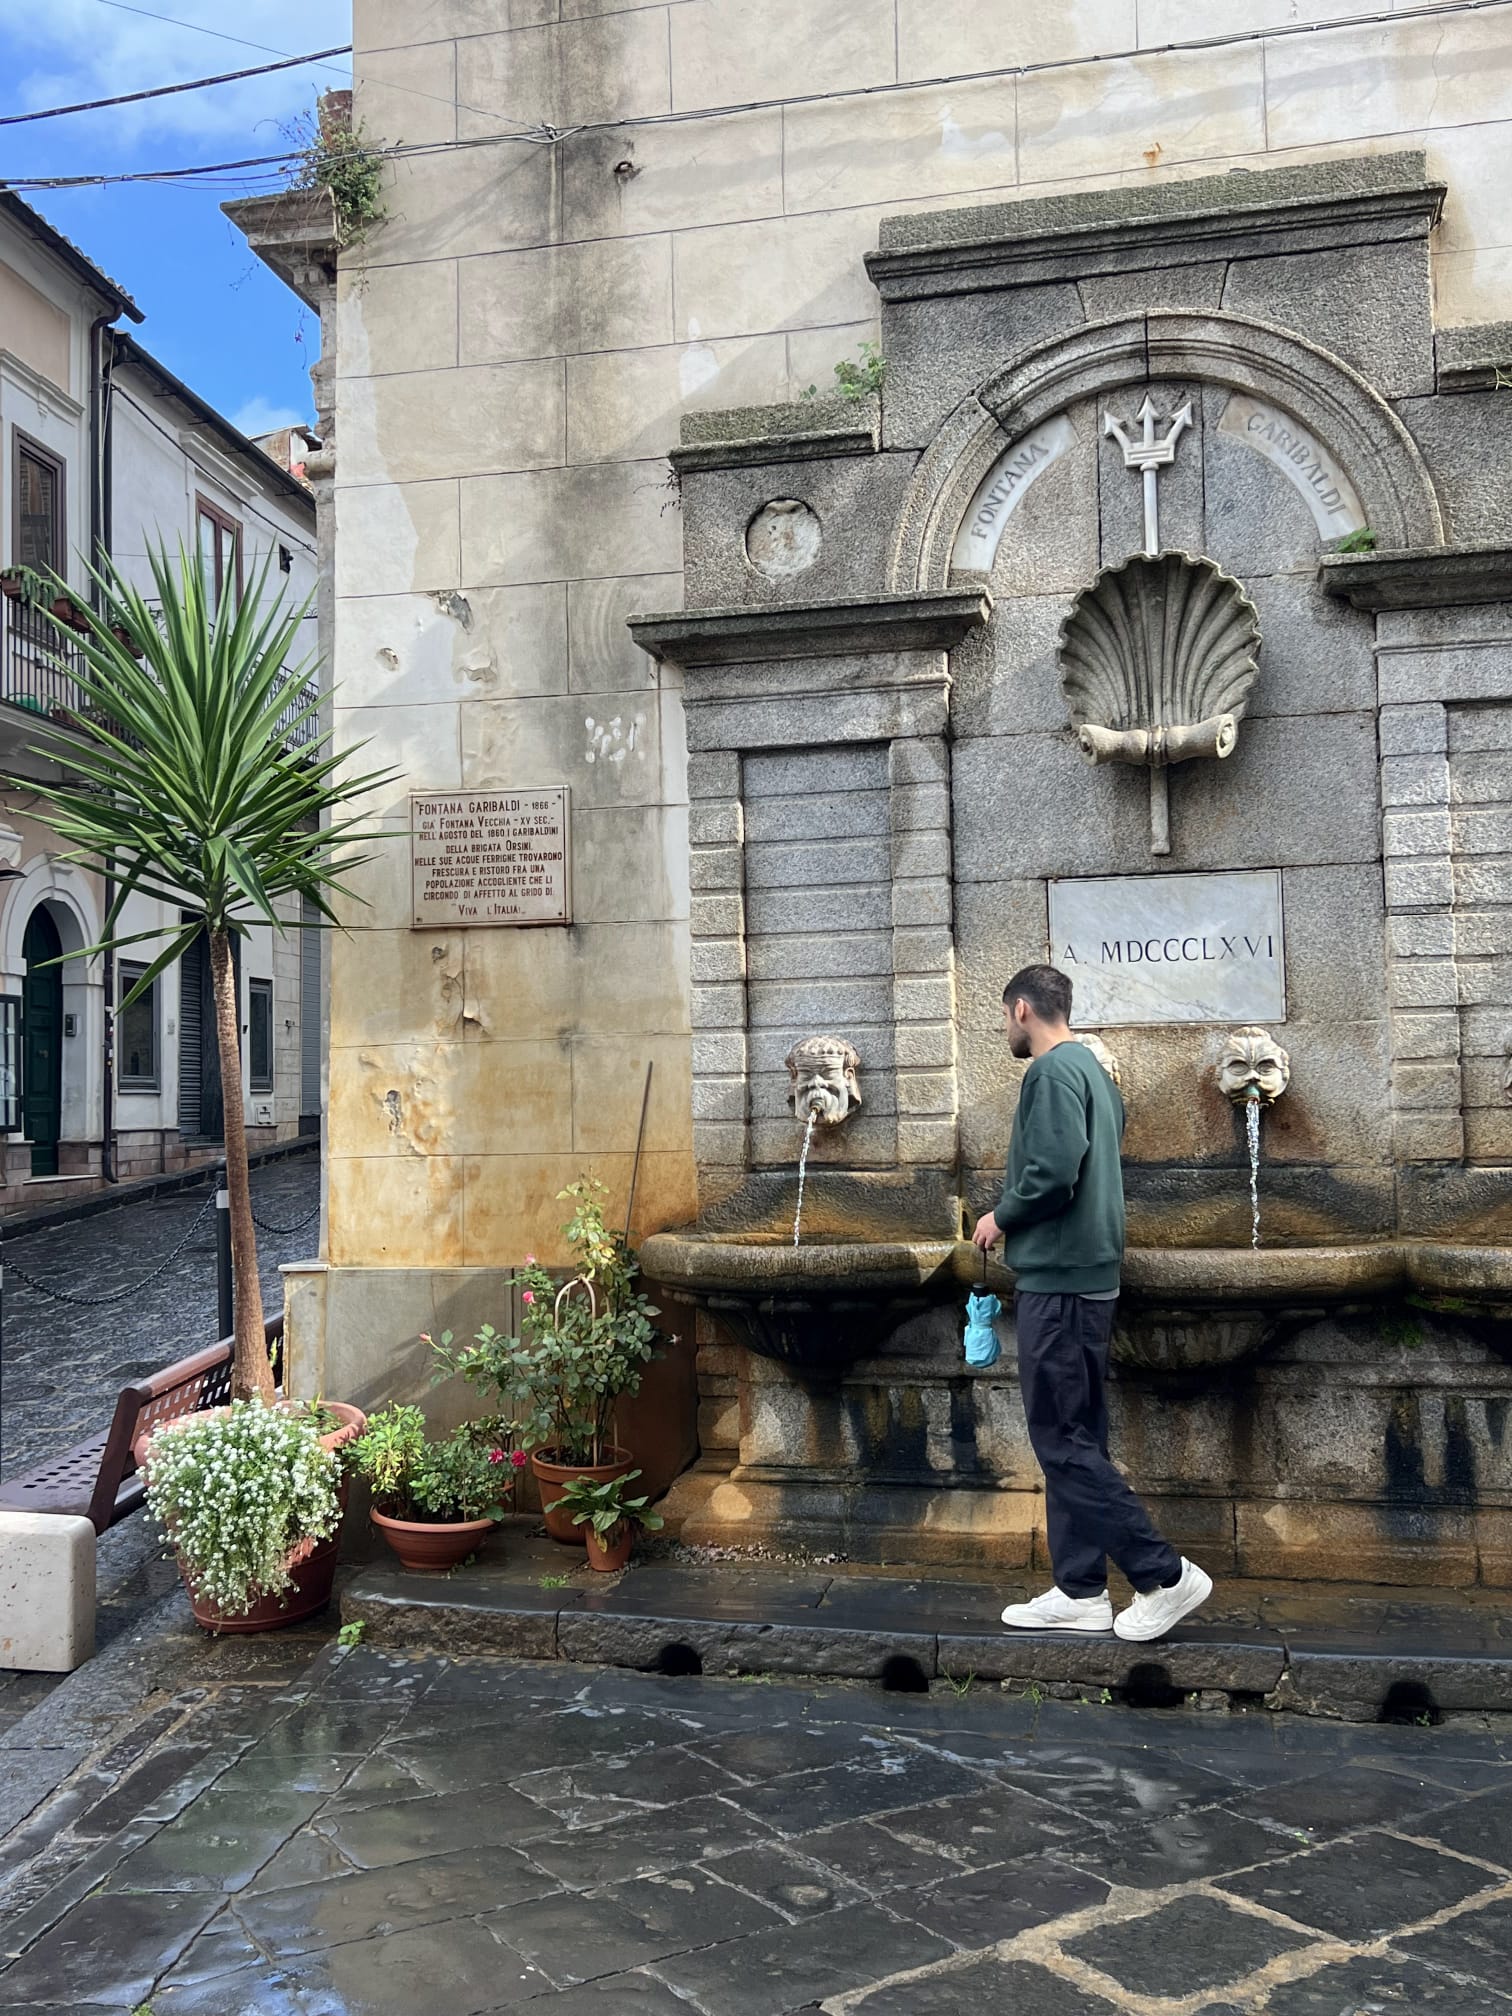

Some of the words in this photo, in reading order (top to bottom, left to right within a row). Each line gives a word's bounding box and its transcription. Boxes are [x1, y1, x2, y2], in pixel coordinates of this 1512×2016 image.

[1247, 412, 1346, 515] GARIBALDI
[970, 443, 1049, 540] FONTANA
[418, 802, 463, 816] FONTANA
[468, 799, 520, 814] GARIBALDI
[531, 801, 549, 810] 1866
[440, 817, 474, 830] FONTANA
[477, 815, 511, 828] VECCHIA
[520, 816, 531, 826] XV
[470, 829, 483, 839] DEL
[488, 828, 505, 838] 1860
[512, 826, 559, 837] GARIBALDINI
[446, 844, 468, 854] DELLA
[471, 842, 501, 853] BRIGATA
[415, 857, 436, 866] NELLE
[439, 856, 453, 866] SUE
[456, 855, 480, 865] ACQUE
[482, 853, 516, 864] FERRIGNE
[519, 852, 563, 862] TROVARONO
[432, 867, 470, 878] FRESCURA
[479, 865, 510, 876] RISTORO
[512, 864, 528, 874] FRA
[530, 864, 545, 873] UNA
[425, 878, 475, 890] POPOLAZIONE
[477, 876, 527, 887] ACCOGLIENTE
[529, 875, 543, 885] CHE
[545, 875, 553, 884] LI
[463, 890, 471, 899] DI
[473, 888, 506, 899] AFFETTO
[508, 888, 518, 897] AL
[521, 887, 543, 897] GRIDO
[1101, 935, 1273, 964] MDCCCLXVI
